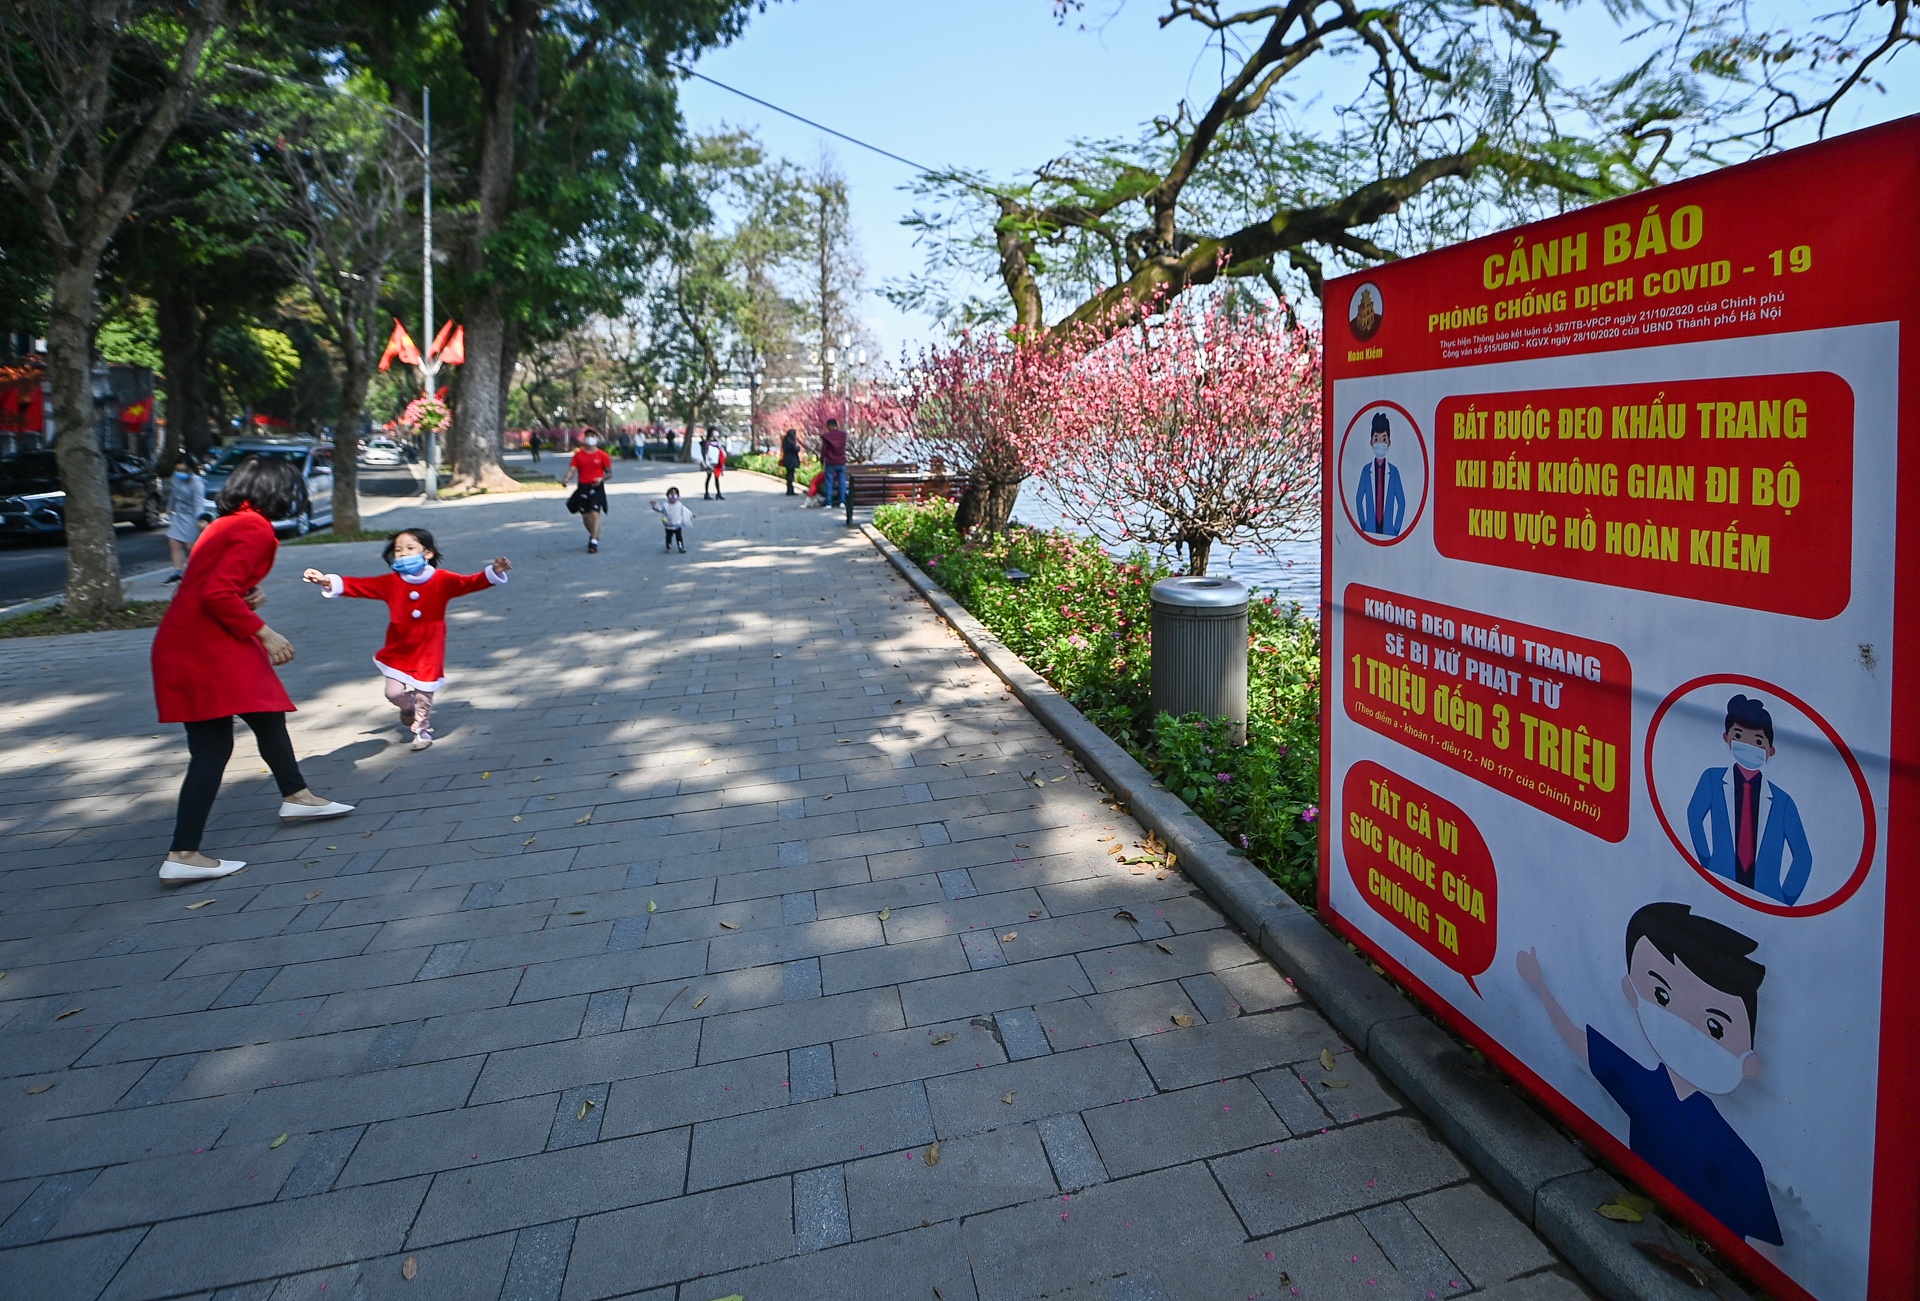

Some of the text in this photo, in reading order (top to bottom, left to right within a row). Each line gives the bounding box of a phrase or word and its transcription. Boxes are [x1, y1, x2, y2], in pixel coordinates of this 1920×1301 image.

[1483, 204, 1703, 290] CẢNH BÁO
[1428, 245, 1811, 333] PHÒNG CHỐNG DỊCH COVID - 19
[1554, 316, 1611, 332] 367/TB-VPCP
[1614, 313, 1637, 326] ngày
[1640, 304, 1694, 321] 21/10/2020
[1721, 295, 1756, 309] Chính
[1484, 341, 1520, 354] 515/UBND
[1525, 338, 1549, 348] KGVX
[1551, 334, 1571, 346] ngày
[1573, 327, 1620, 343] 28/10/2020
[1642, 320, 1673, 334] UBND
[1677, 315, 1710, 330] Thành
[1714, 310, 1737, 327] phố
[1740, 309, 1756, 322] Hà
[1760, 306, 1782, 321] Nội
[1453, 391, 1807, 445] BẮT BUỘC ĐEO KHẨU TRANG
[1455, 451, 1801, 515] KHI ĐẾN KHÔNG GIAN ĐI BỘ
[1468, 508, 1771, 574] KHU VỰC HỒ HOÀN KIẾM
[1364, 598, 1601, 682] KHÔNG ĐEO KHẨU TRANG
[1385, 632, 1564, 710] SẼ BỊ XỬ PHẠT TỪ
[1351, 653, 1616, 793] 1 TRIỆU đến 3 TRIỆU
[1355, 702, 1374, 717] (Theo
[1393, 720, 1398, 728] a
[1430, 735, 1435, 745] 1
[1462, 749, 1473, 762] 12
[1480, 756, 1495, 771] NĐ
[1497, 764, 1514, 780] 117
[1516, 774, 1535, 790] của
[1538, 782, 1571, 806] Chính
[1573, 799, 1601, 822] phủ)
[1369, 779, 1459, 856] TẤT CẢ VÌ
[1350, 811, 1486, 924] SỨC KHỎE CỦA
[1368, 867, 1459, 956] CHÚNG TA
